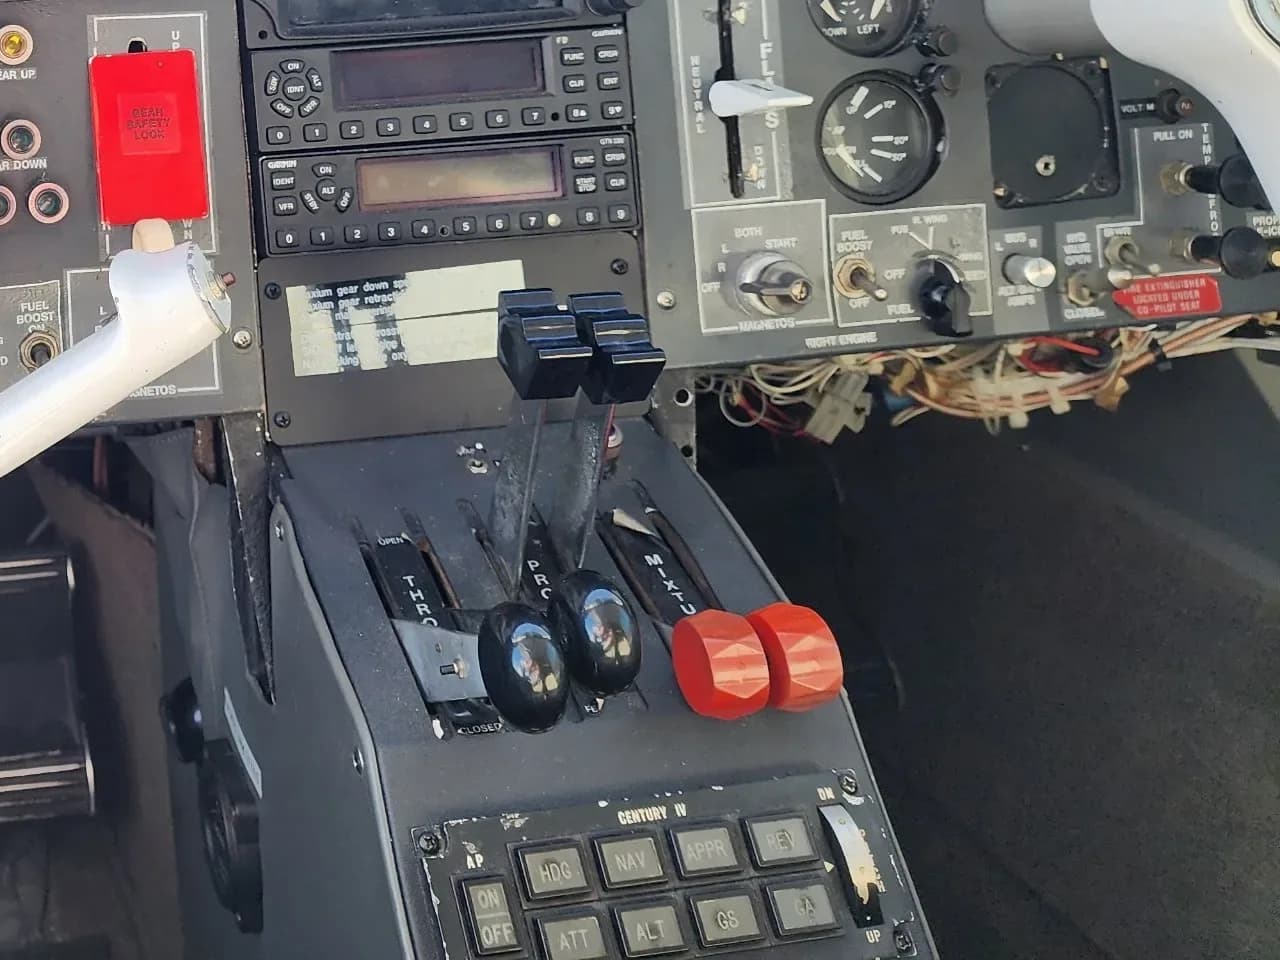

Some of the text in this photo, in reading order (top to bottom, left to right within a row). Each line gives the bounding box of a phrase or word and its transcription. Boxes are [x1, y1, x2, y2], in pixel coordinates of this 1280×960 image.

[21, 69, 36, 79] UP
[13, 158, 47, 171] DOWN
[735, 227, 762, 237] BOTH
[841, 231, 866, 241] FUEL
[765, 238, 797, 249] START
[837, 240, 872, 251] BOOST
[337, 281, 389, 297] gear down
[1145, 278, 1206, 290] EXTINGUISHER
[338, 298, 360, 310] gear
[1132, 290, 1200, 305] LOCATED UNDER
[21, 301, 49, 312] FUEL
[1137, 304, 1172, 315] CO-PILOT
[16, 311, 55, 324] BOOST
[740, 318, 796, 331] MAGNETOS
[617, 806, 668, 825] CENTURY
[686, 840, 728, 861] APPR
[614, 852, 646, 871] NAV
[540, 864, 572, 883] HDG
[717, 911, 740, 931] GS
[481, 923, 513, 944] OFF
[637, 920, 664, 941] ALT
[866, 930, 881, 943] UP
[560, 929, 589, 950] ATT
